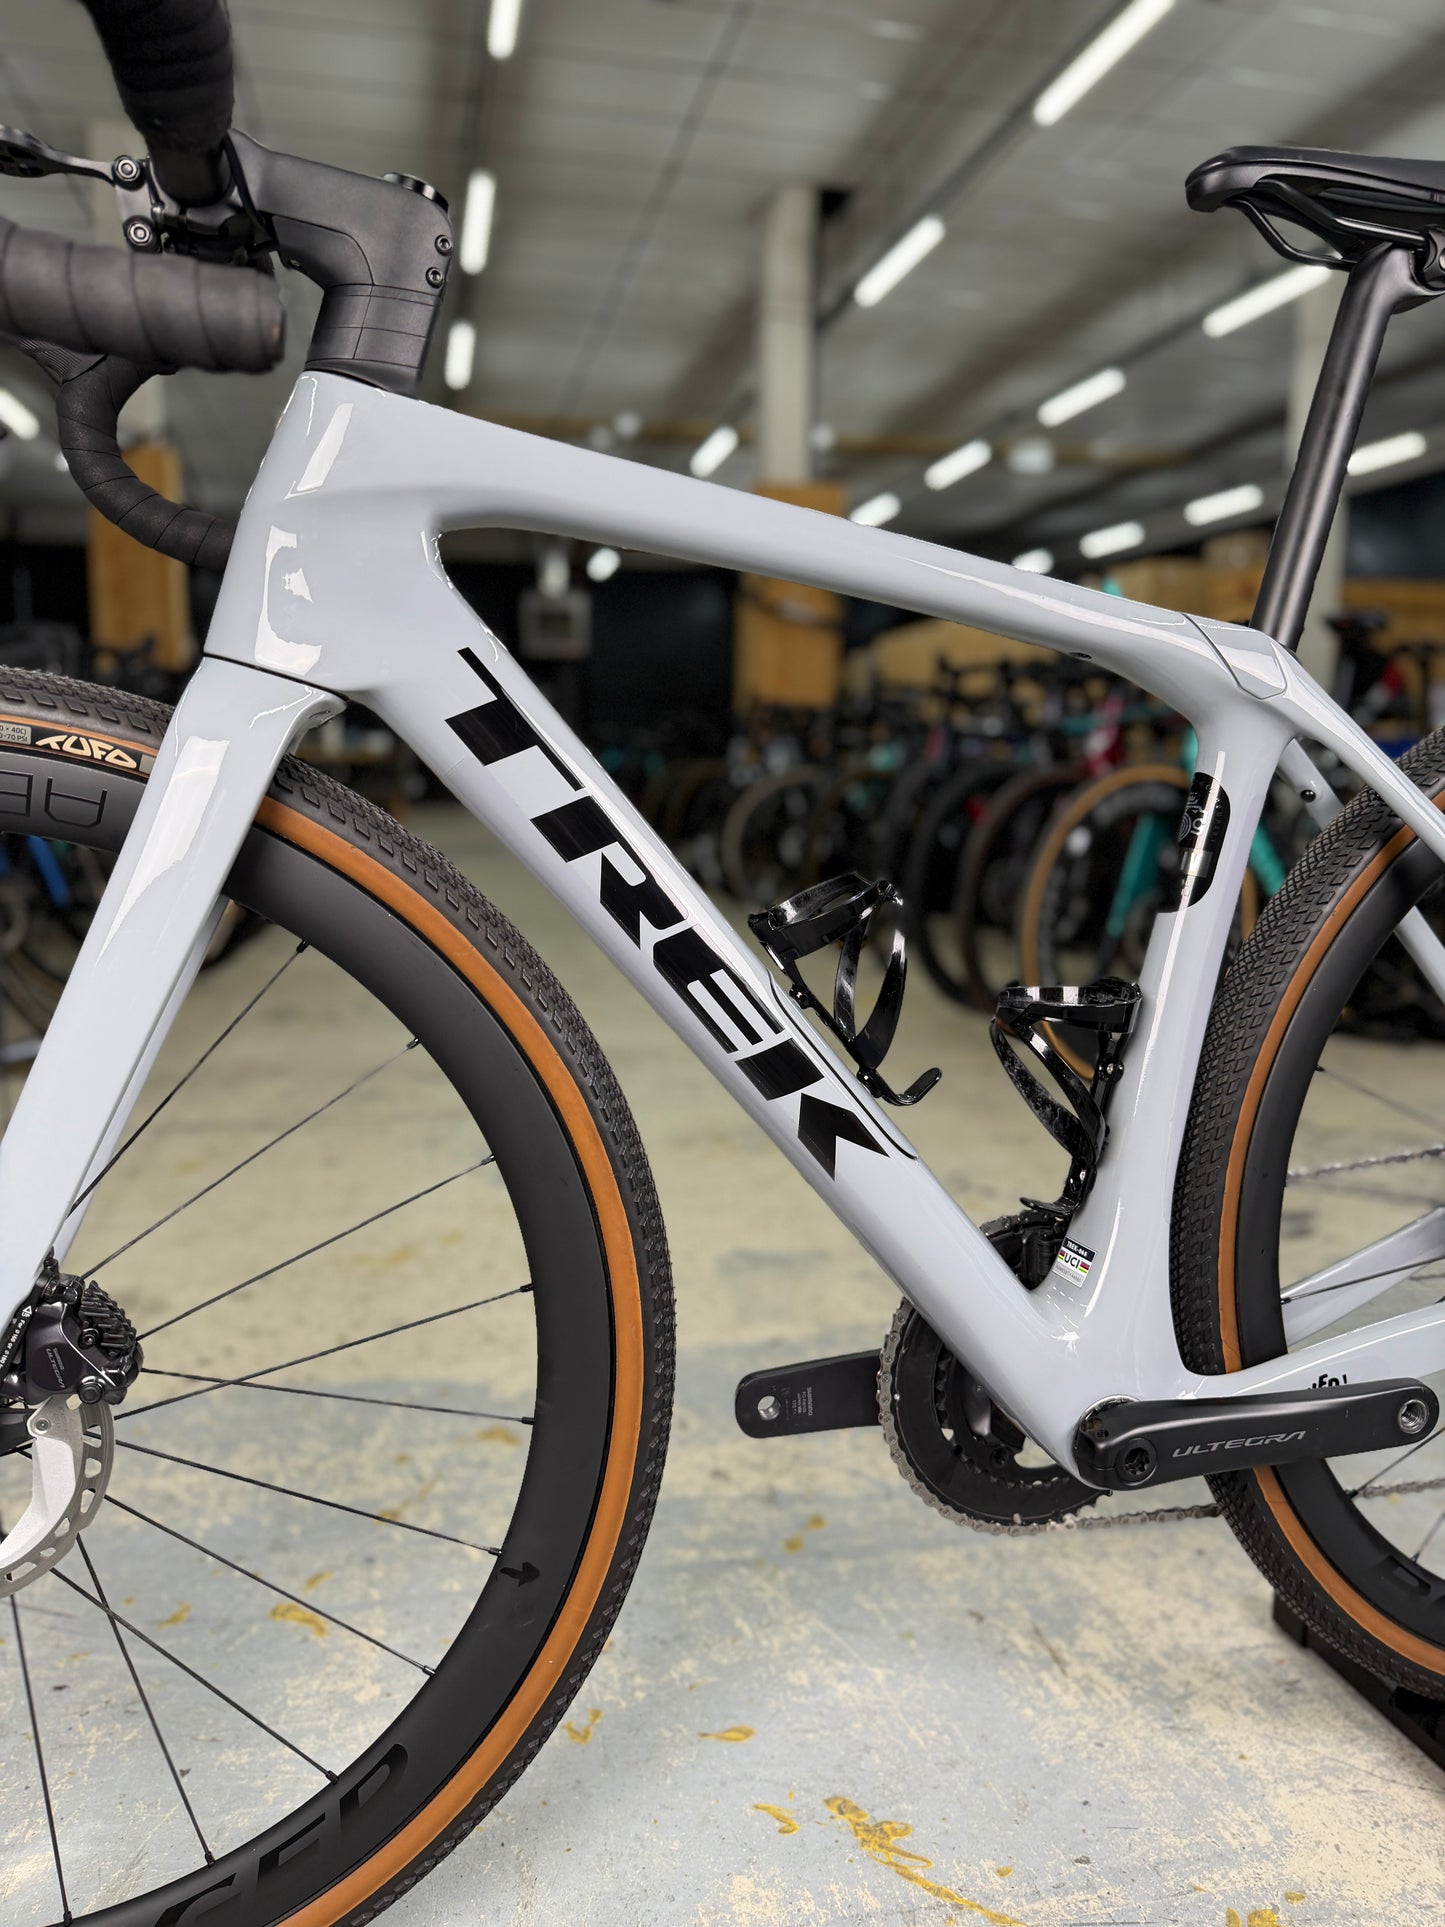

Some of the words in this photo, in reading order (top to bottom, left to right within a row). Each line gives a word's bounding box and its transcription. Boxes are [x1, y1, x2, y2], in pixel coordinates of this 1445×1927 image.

[35, 734, 137, 769] TUFO
[444, 646, 890, 1182] TREK
[1064, 1252, 1080, 1269] UCI
[46, 1348, 66, 1389] ULTEGRA
[1172, 1430, 1307, 1458] ULTEGRA
